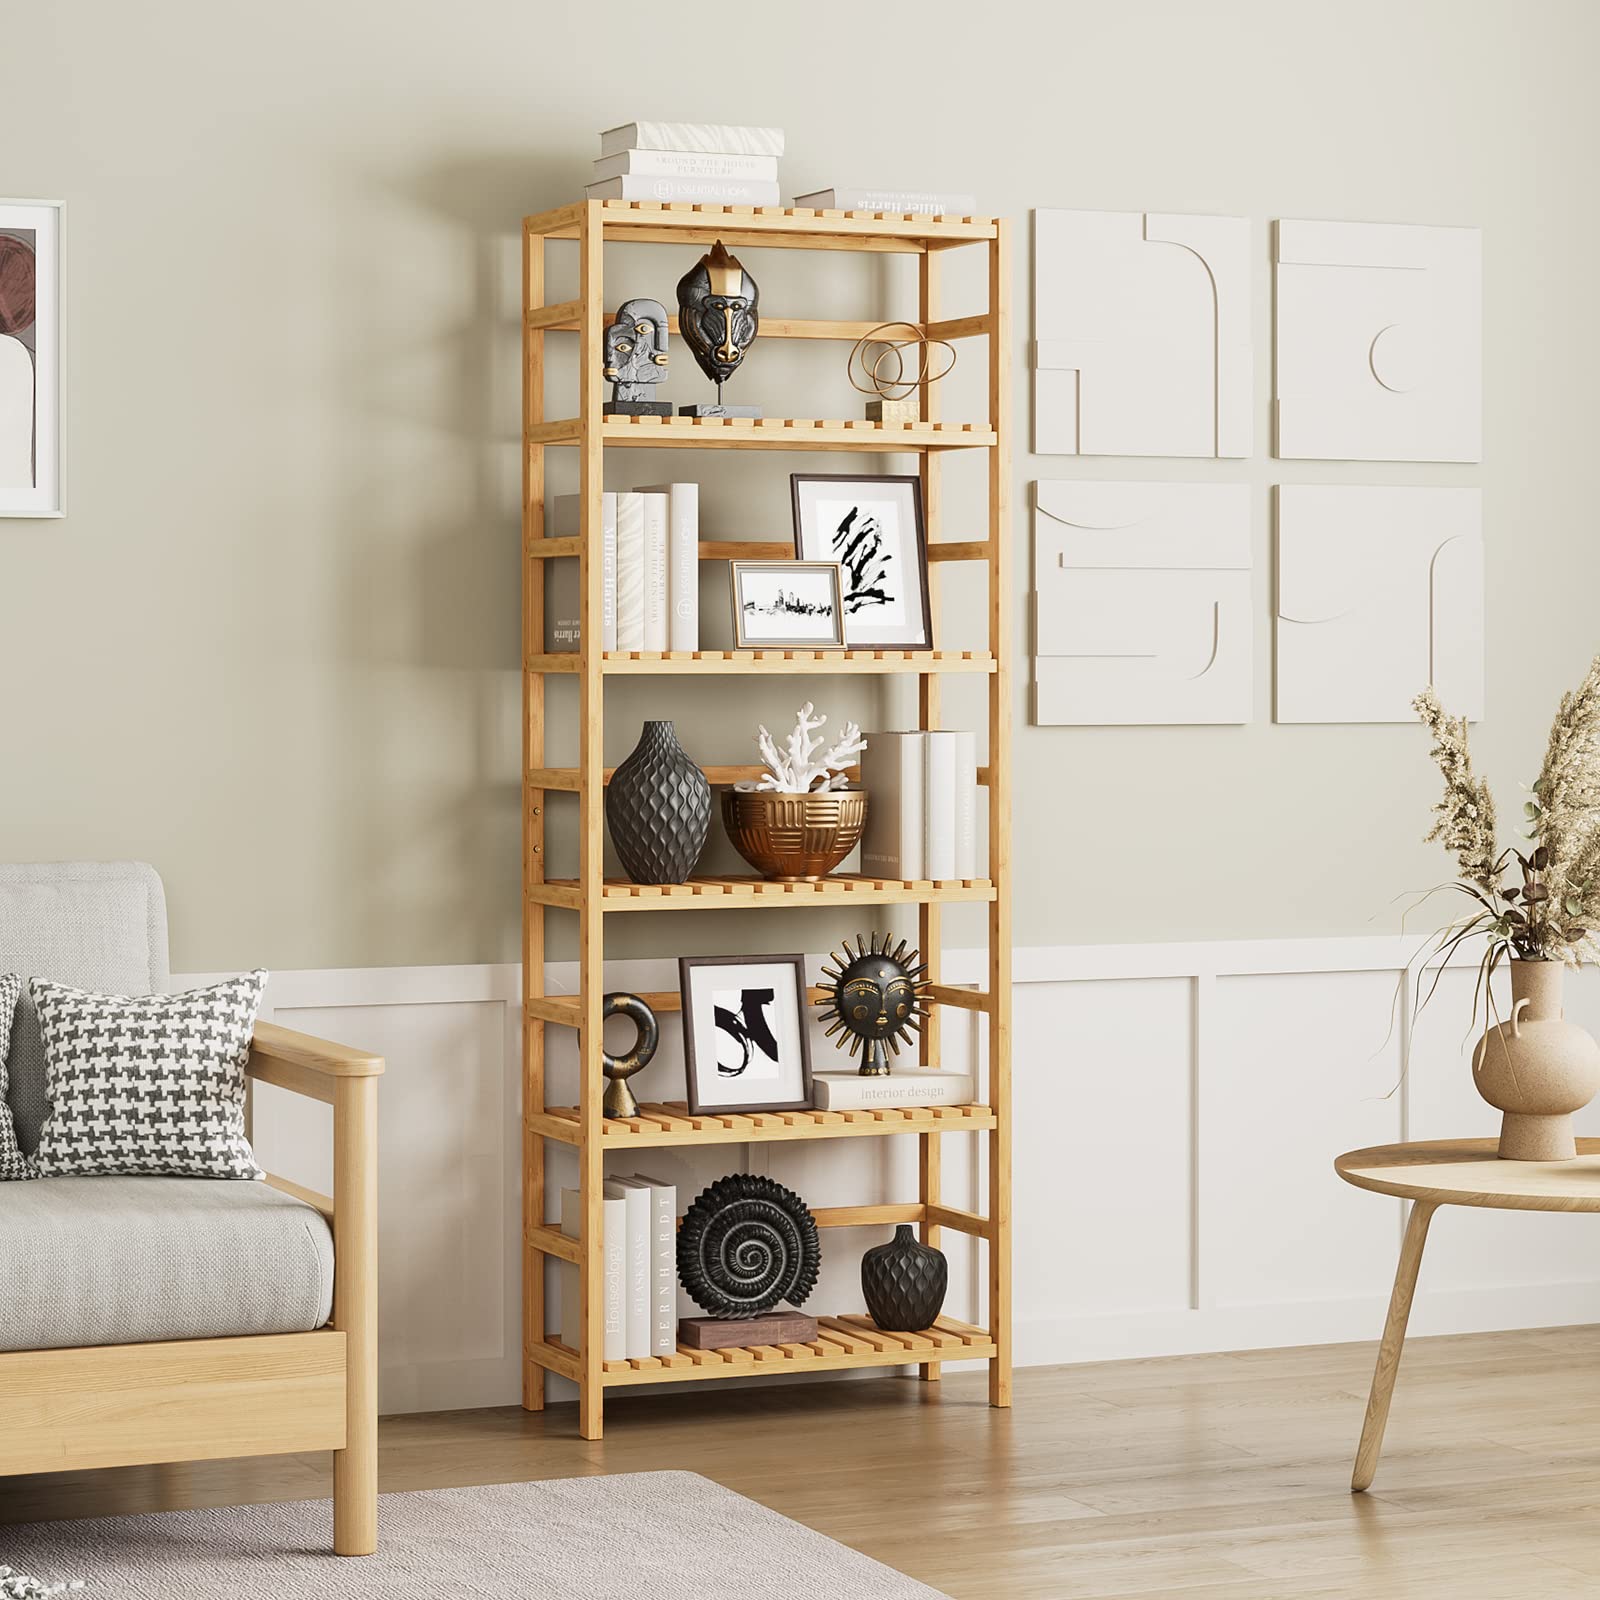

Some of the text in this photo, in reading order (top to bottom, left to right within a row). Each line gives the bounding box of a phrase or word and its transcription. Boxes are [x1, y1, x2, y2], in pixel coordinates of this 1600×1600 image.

[604, 527, 615, 627] Miller Harris
[860, 1085, 945, 1100] interior design
[660, 1199, 670, 1347] BERNHARDT
